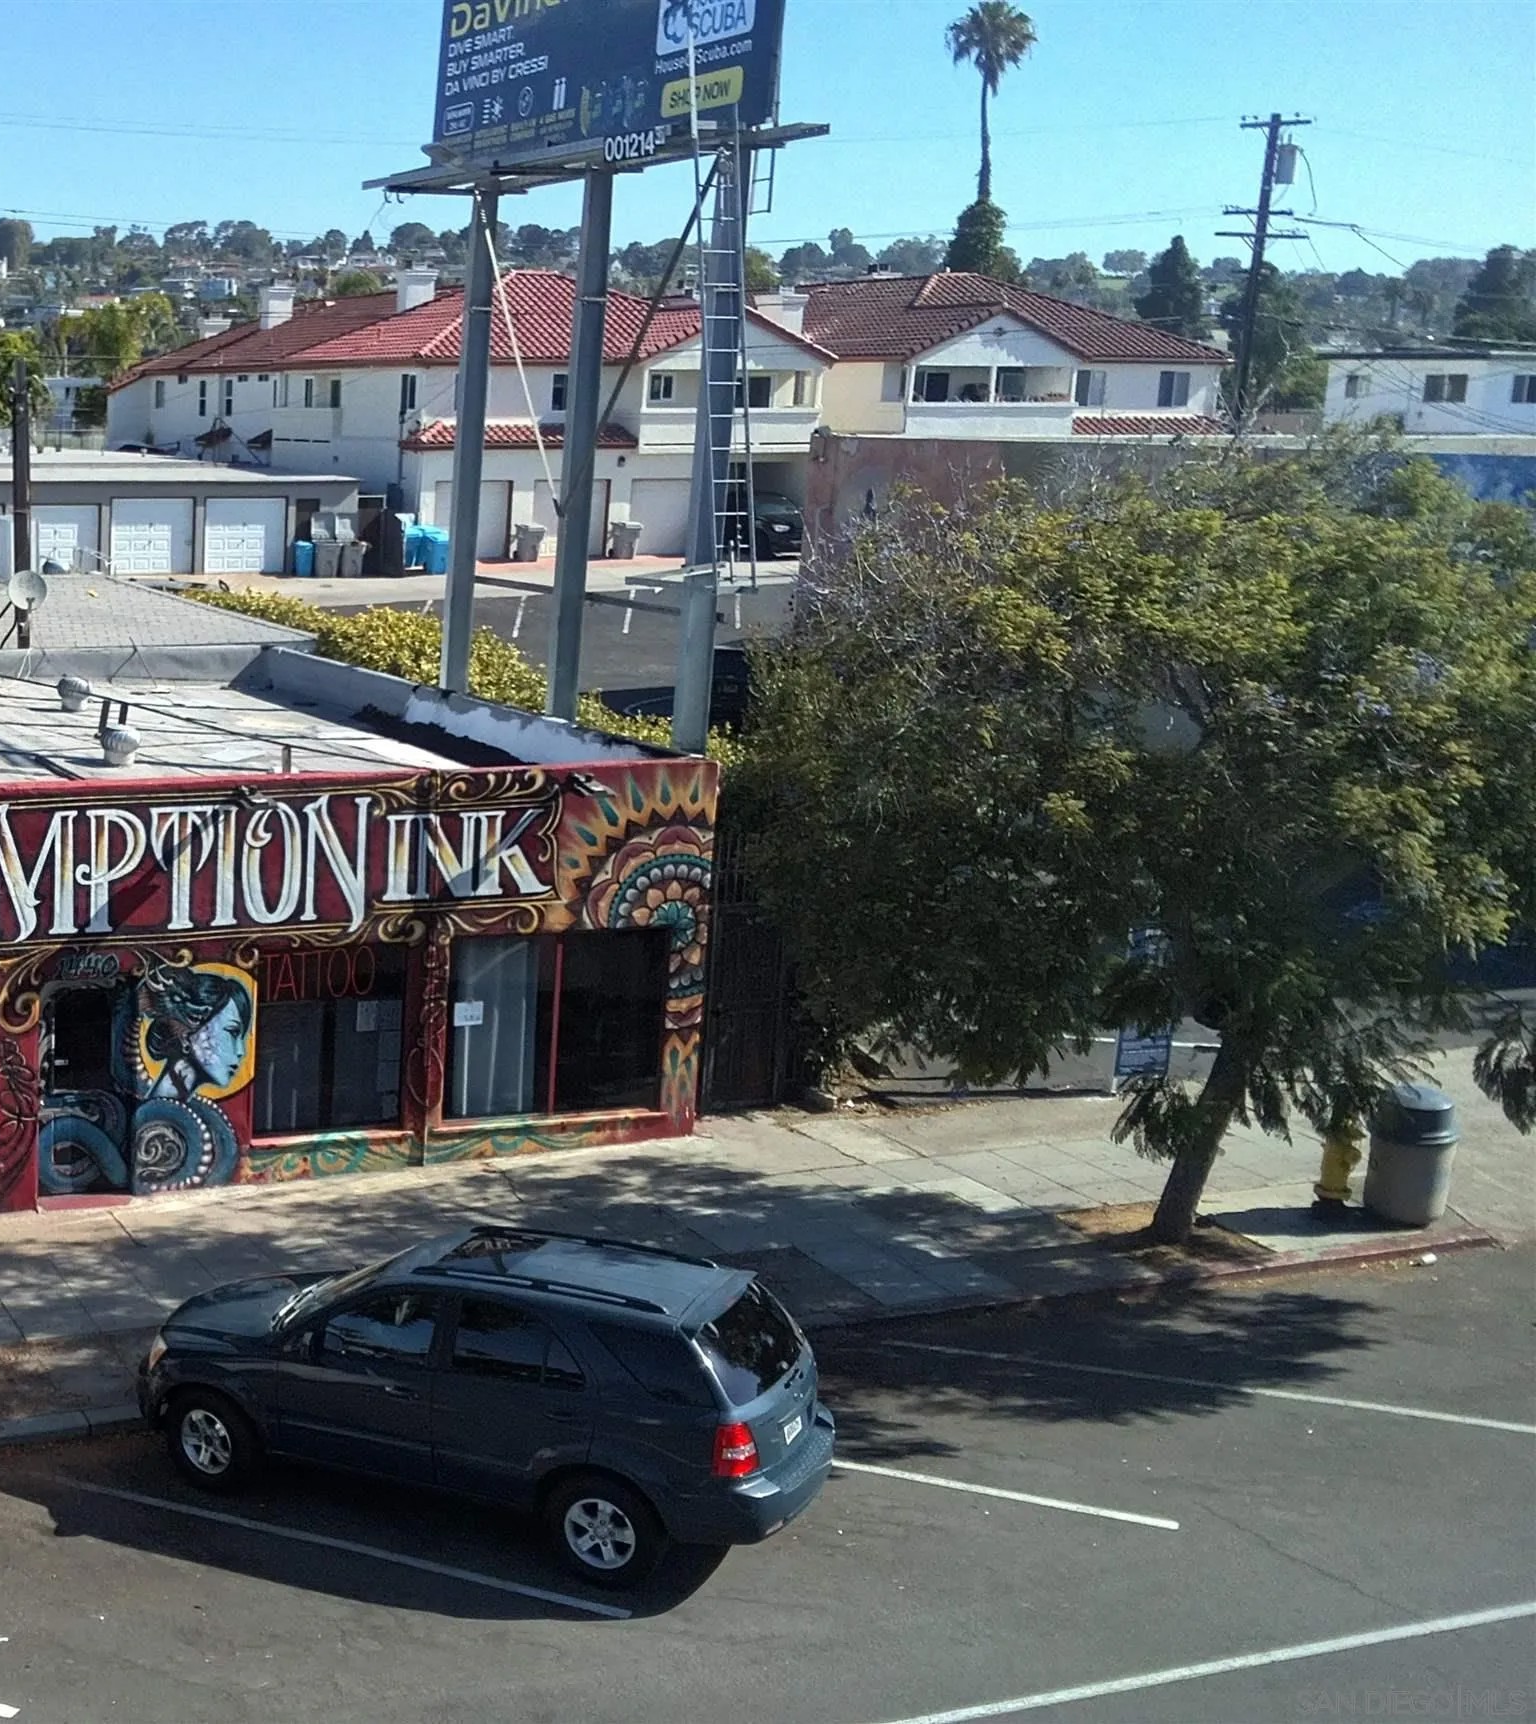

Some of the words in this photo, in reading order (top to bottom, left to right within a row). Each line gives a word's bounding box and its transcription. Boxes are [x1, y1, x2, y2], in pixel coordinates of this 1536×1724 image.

[690, 1, 748, 40] SCUBA
[448, 38, 473, 58] DIVE
[444, 81, 460, 97] DA
[462, 71, 490, 92] VINCI
[491, 67, 507, 85] BY
[507, 55, 549, 80] CRESSI
[447, 59, 469, 77] BUY
[702, 79, 732, 101] NOW
[604, 130, 655, 162] 001214
[381, 807, 554, 901] INK
[260, 945, 376, 1001] TATTOO
